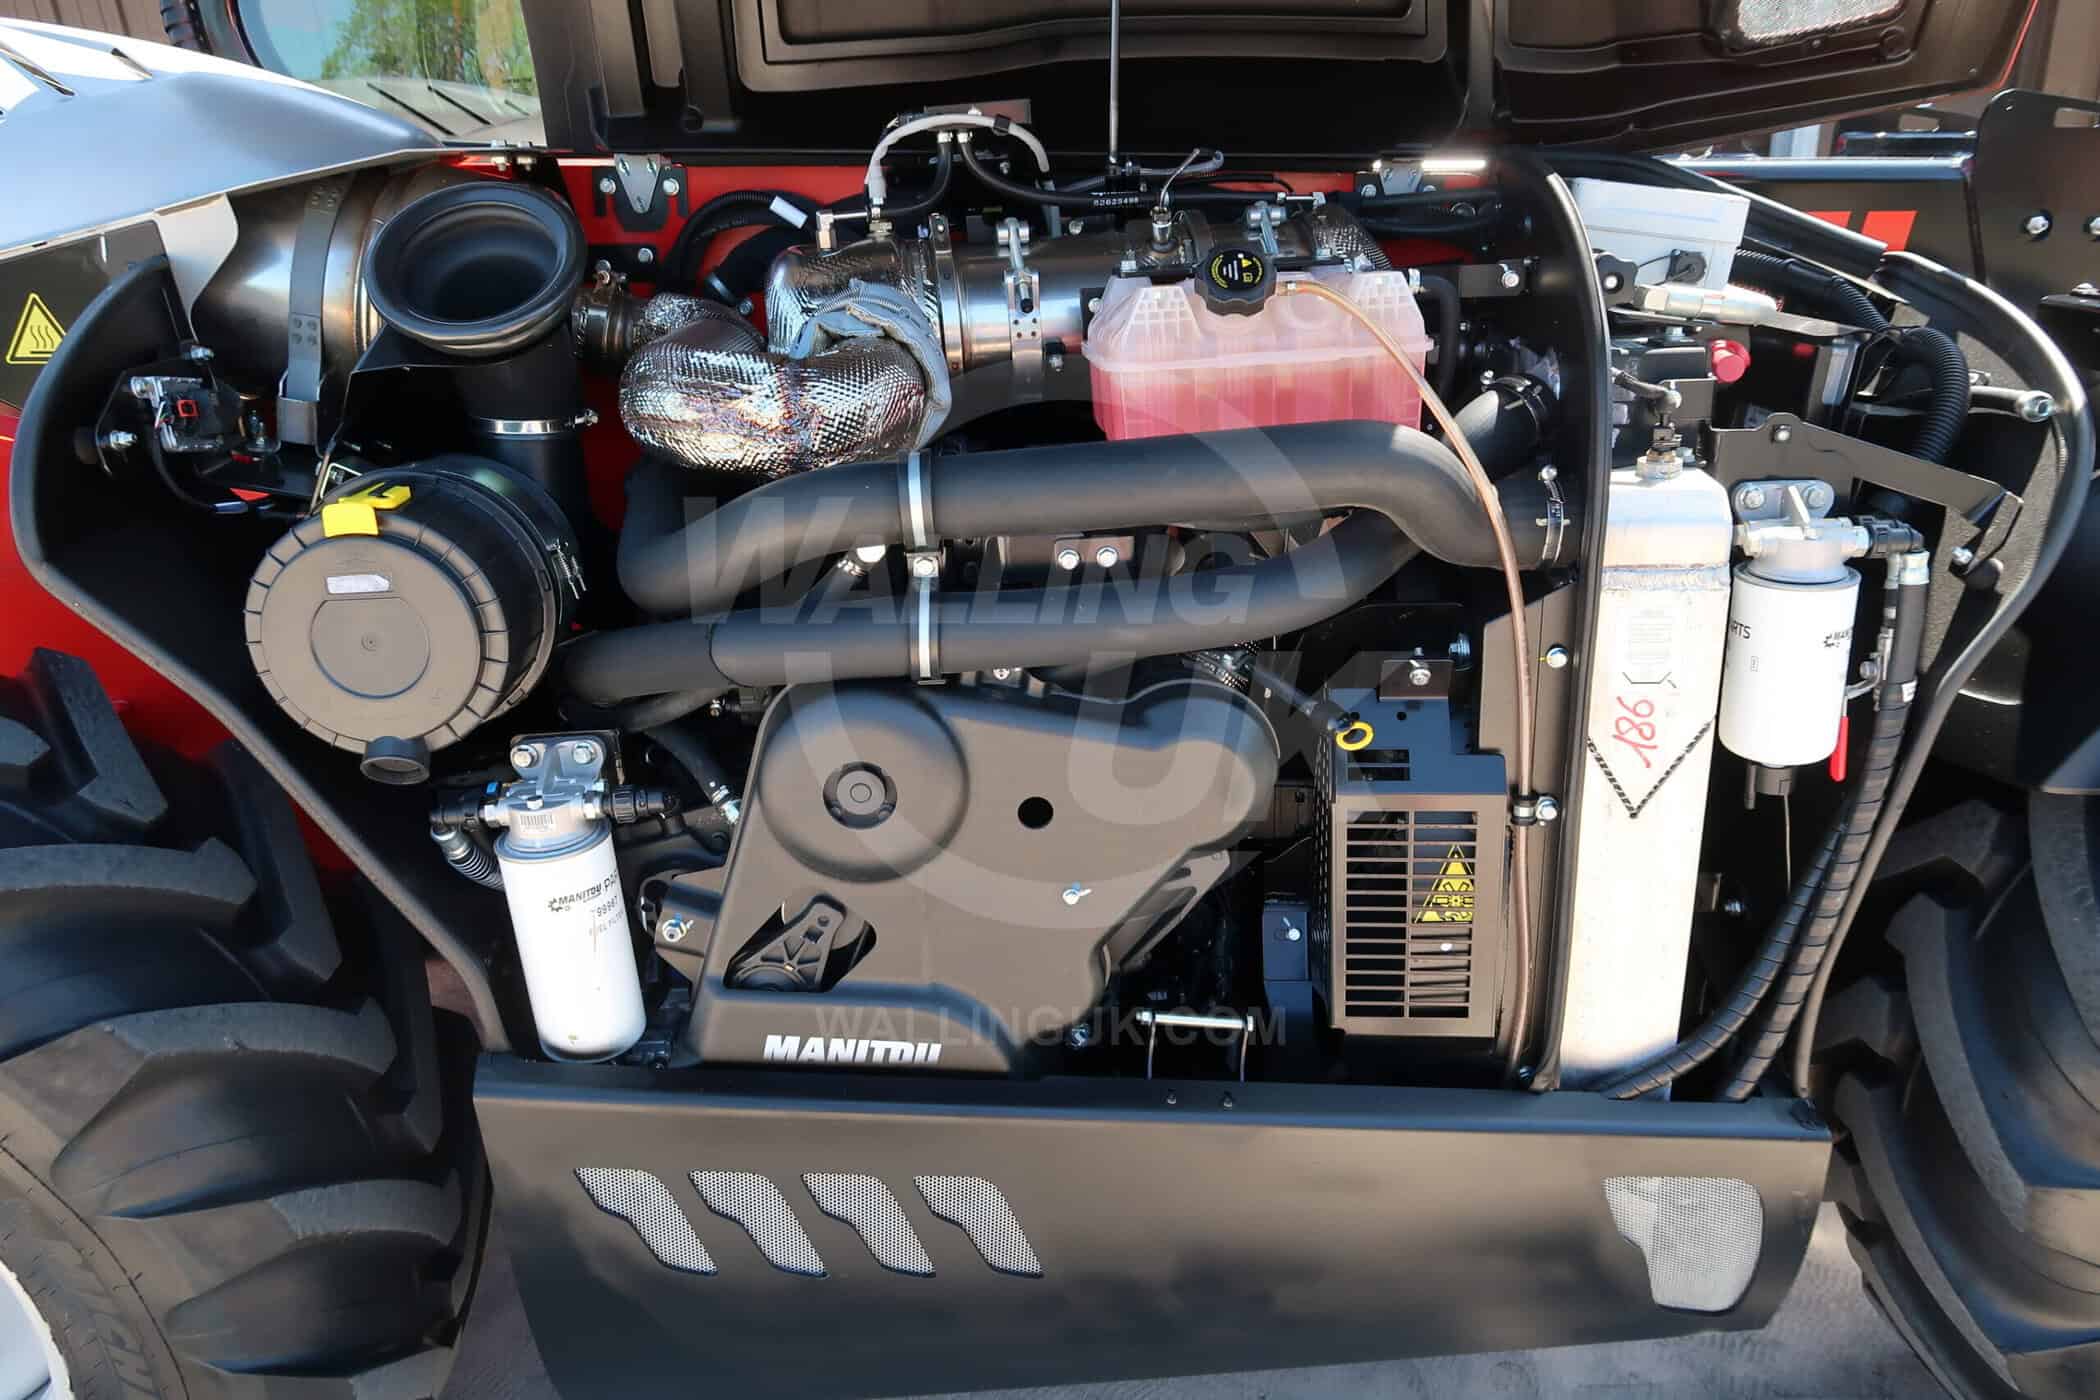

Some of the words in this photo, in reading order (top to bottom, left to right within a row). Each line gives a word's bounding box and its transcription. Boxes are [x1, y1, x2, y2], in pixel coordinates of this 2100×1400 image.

[1612, 696, 1658, 768] 186
[558, 882, 602, 904] MANITOU
[764, 1034, 942, 1063] MANITOU
